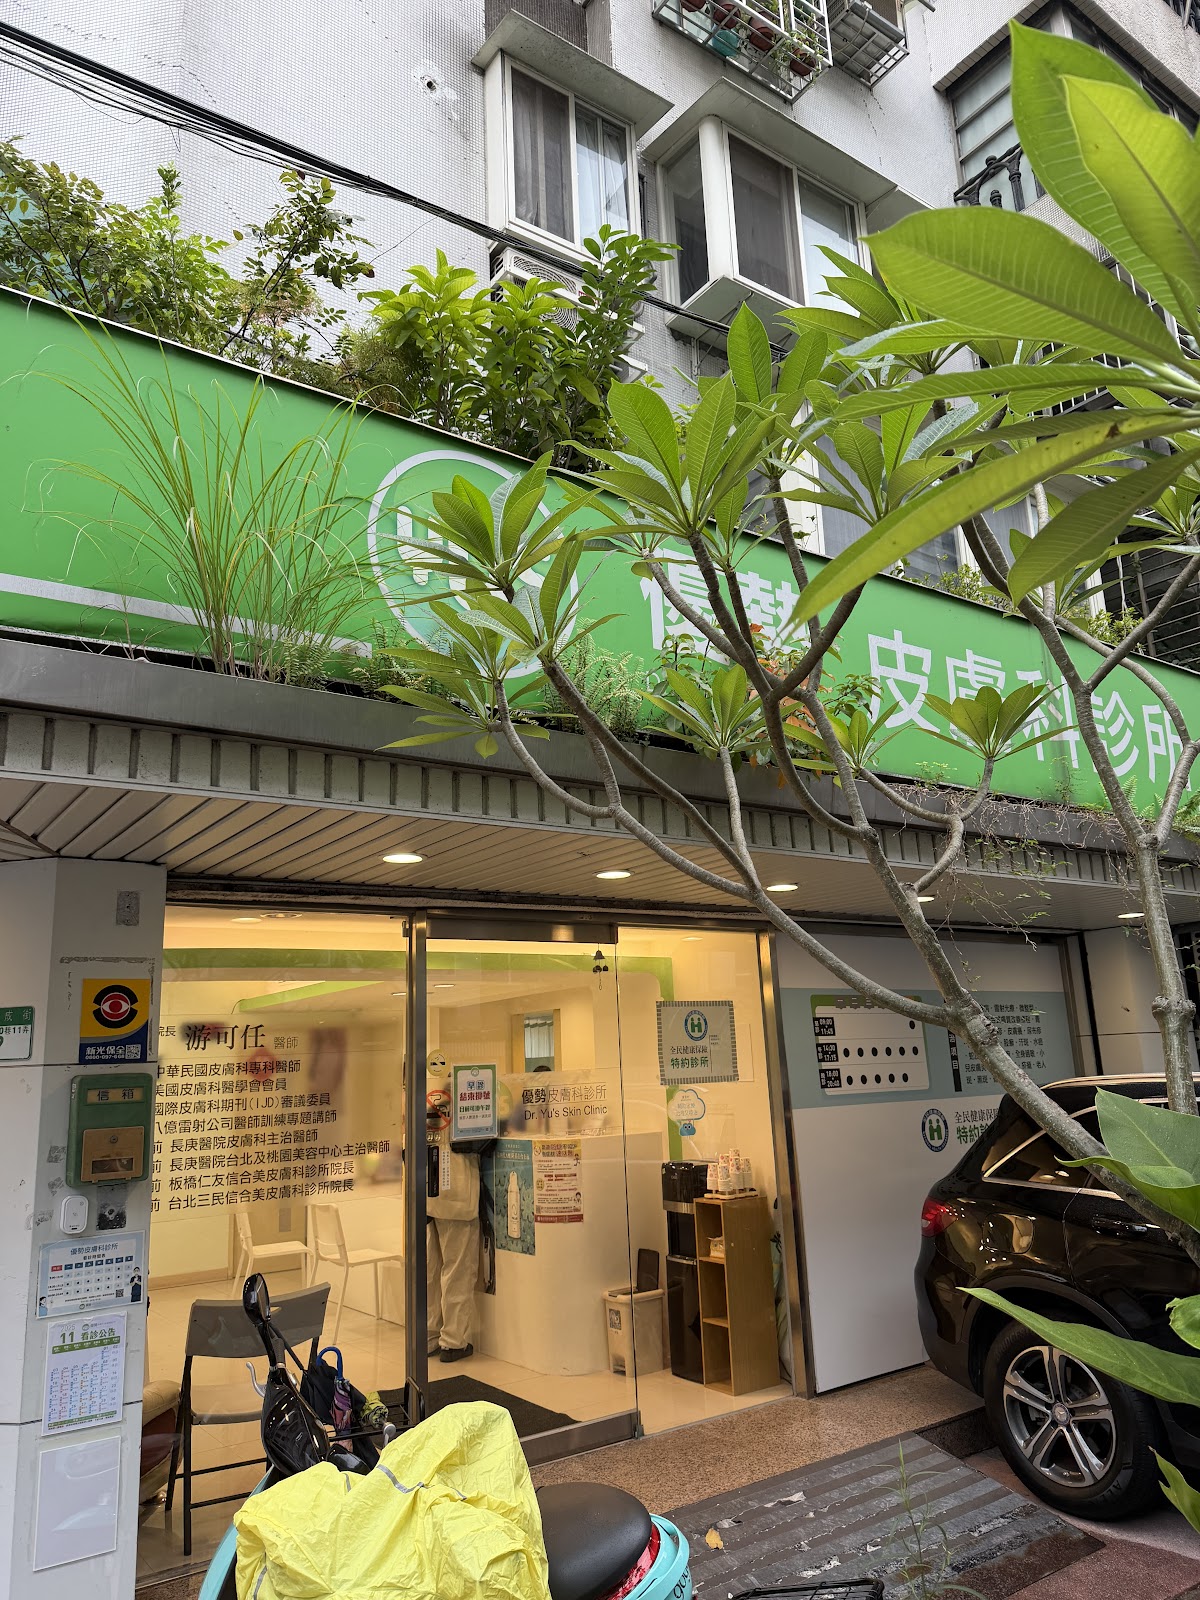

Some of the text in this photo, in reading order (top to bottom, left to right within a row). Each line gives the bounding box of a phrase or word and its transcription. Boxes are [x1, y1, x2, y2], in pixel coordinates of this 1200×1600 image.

[868, 630, 1193, 791] 皮膚科診所
[159, 1024, 299, 1051] 院長 游可任 醫師
[86, 1045, 125, 1055] 新光保全
[670, 1045, 708, 1055] 全民健康保險
[157, 1059, 301, 1079] 中華民國皮膚科專科醫師
[671, 1056, 709, 1070] 特約診所
[97, 1088, 134, 1101] 信箱
[156, 1077, 287, 1097] 美國皮膚科醫學會會員
[521, 1085, 607, 1105] 優勢皮膚科診所
[155, 1092, 331, 1116] 國際皮膚科期刊(IJD)審議委員
[524, 1104, 608, 1120] Dr. Yu's Skin Clinic
[153, 1129, 318, 1155] 前 長庚醫院皮膚科主治醫師
[152, 1140, 390, 1174] 前 長庚醫院台北及桃園美容中心主治醫師
[151, 1161, 355, 1193] 前 板橋仁友信合美皮膚科診所院長
[151, 1178, 354, 1213] 前 台北三民信合美皮膚科診所院長
[60, 1327, 116, 1344] 11 看診公告
